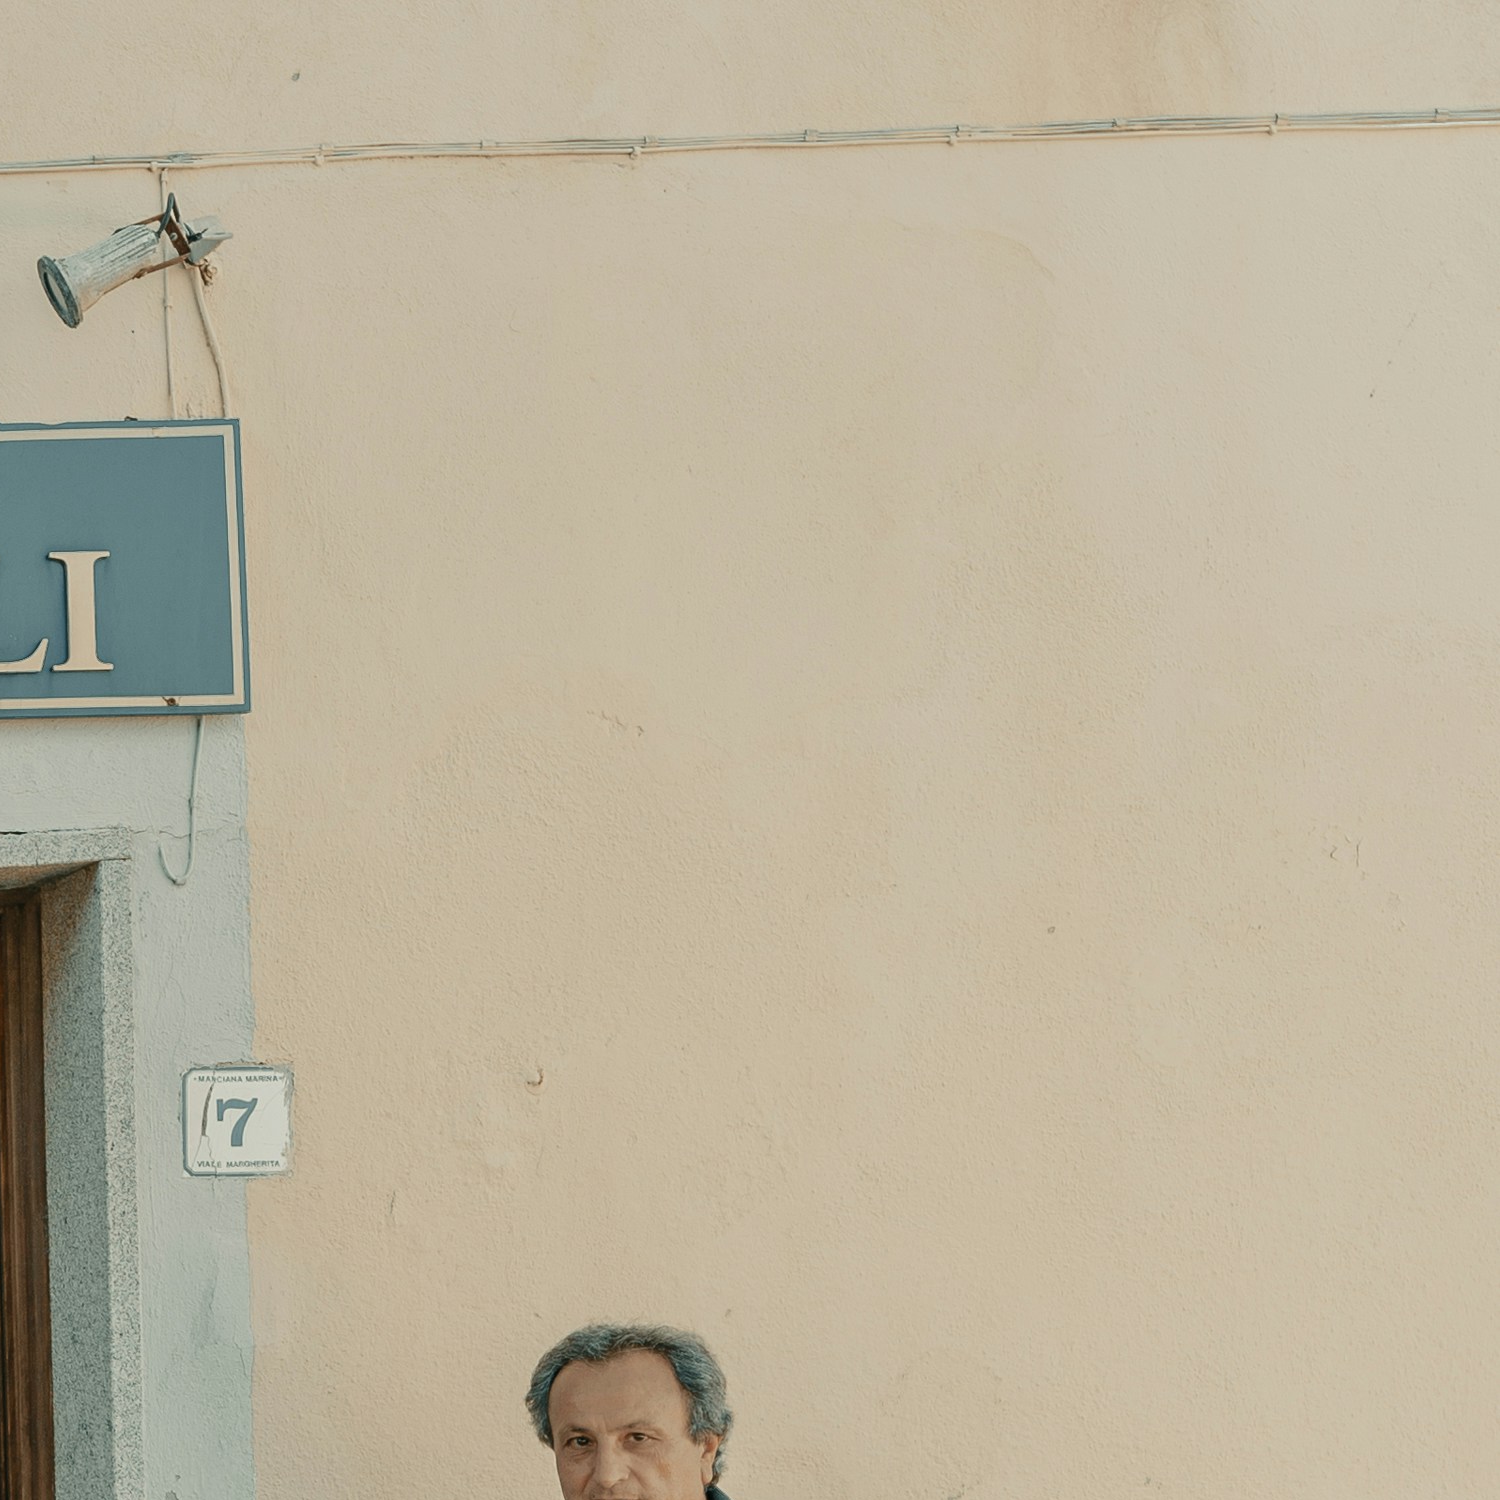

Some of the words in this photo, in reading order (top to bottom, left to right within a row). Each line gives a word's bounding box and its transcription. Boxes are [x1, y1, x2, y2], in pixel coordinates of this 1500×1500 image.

[216, 1098, 258, 1147] 7
[197, 1160, 222, 1168] VIALE
[226, 1160, 280, 1168] MARGHERITA
